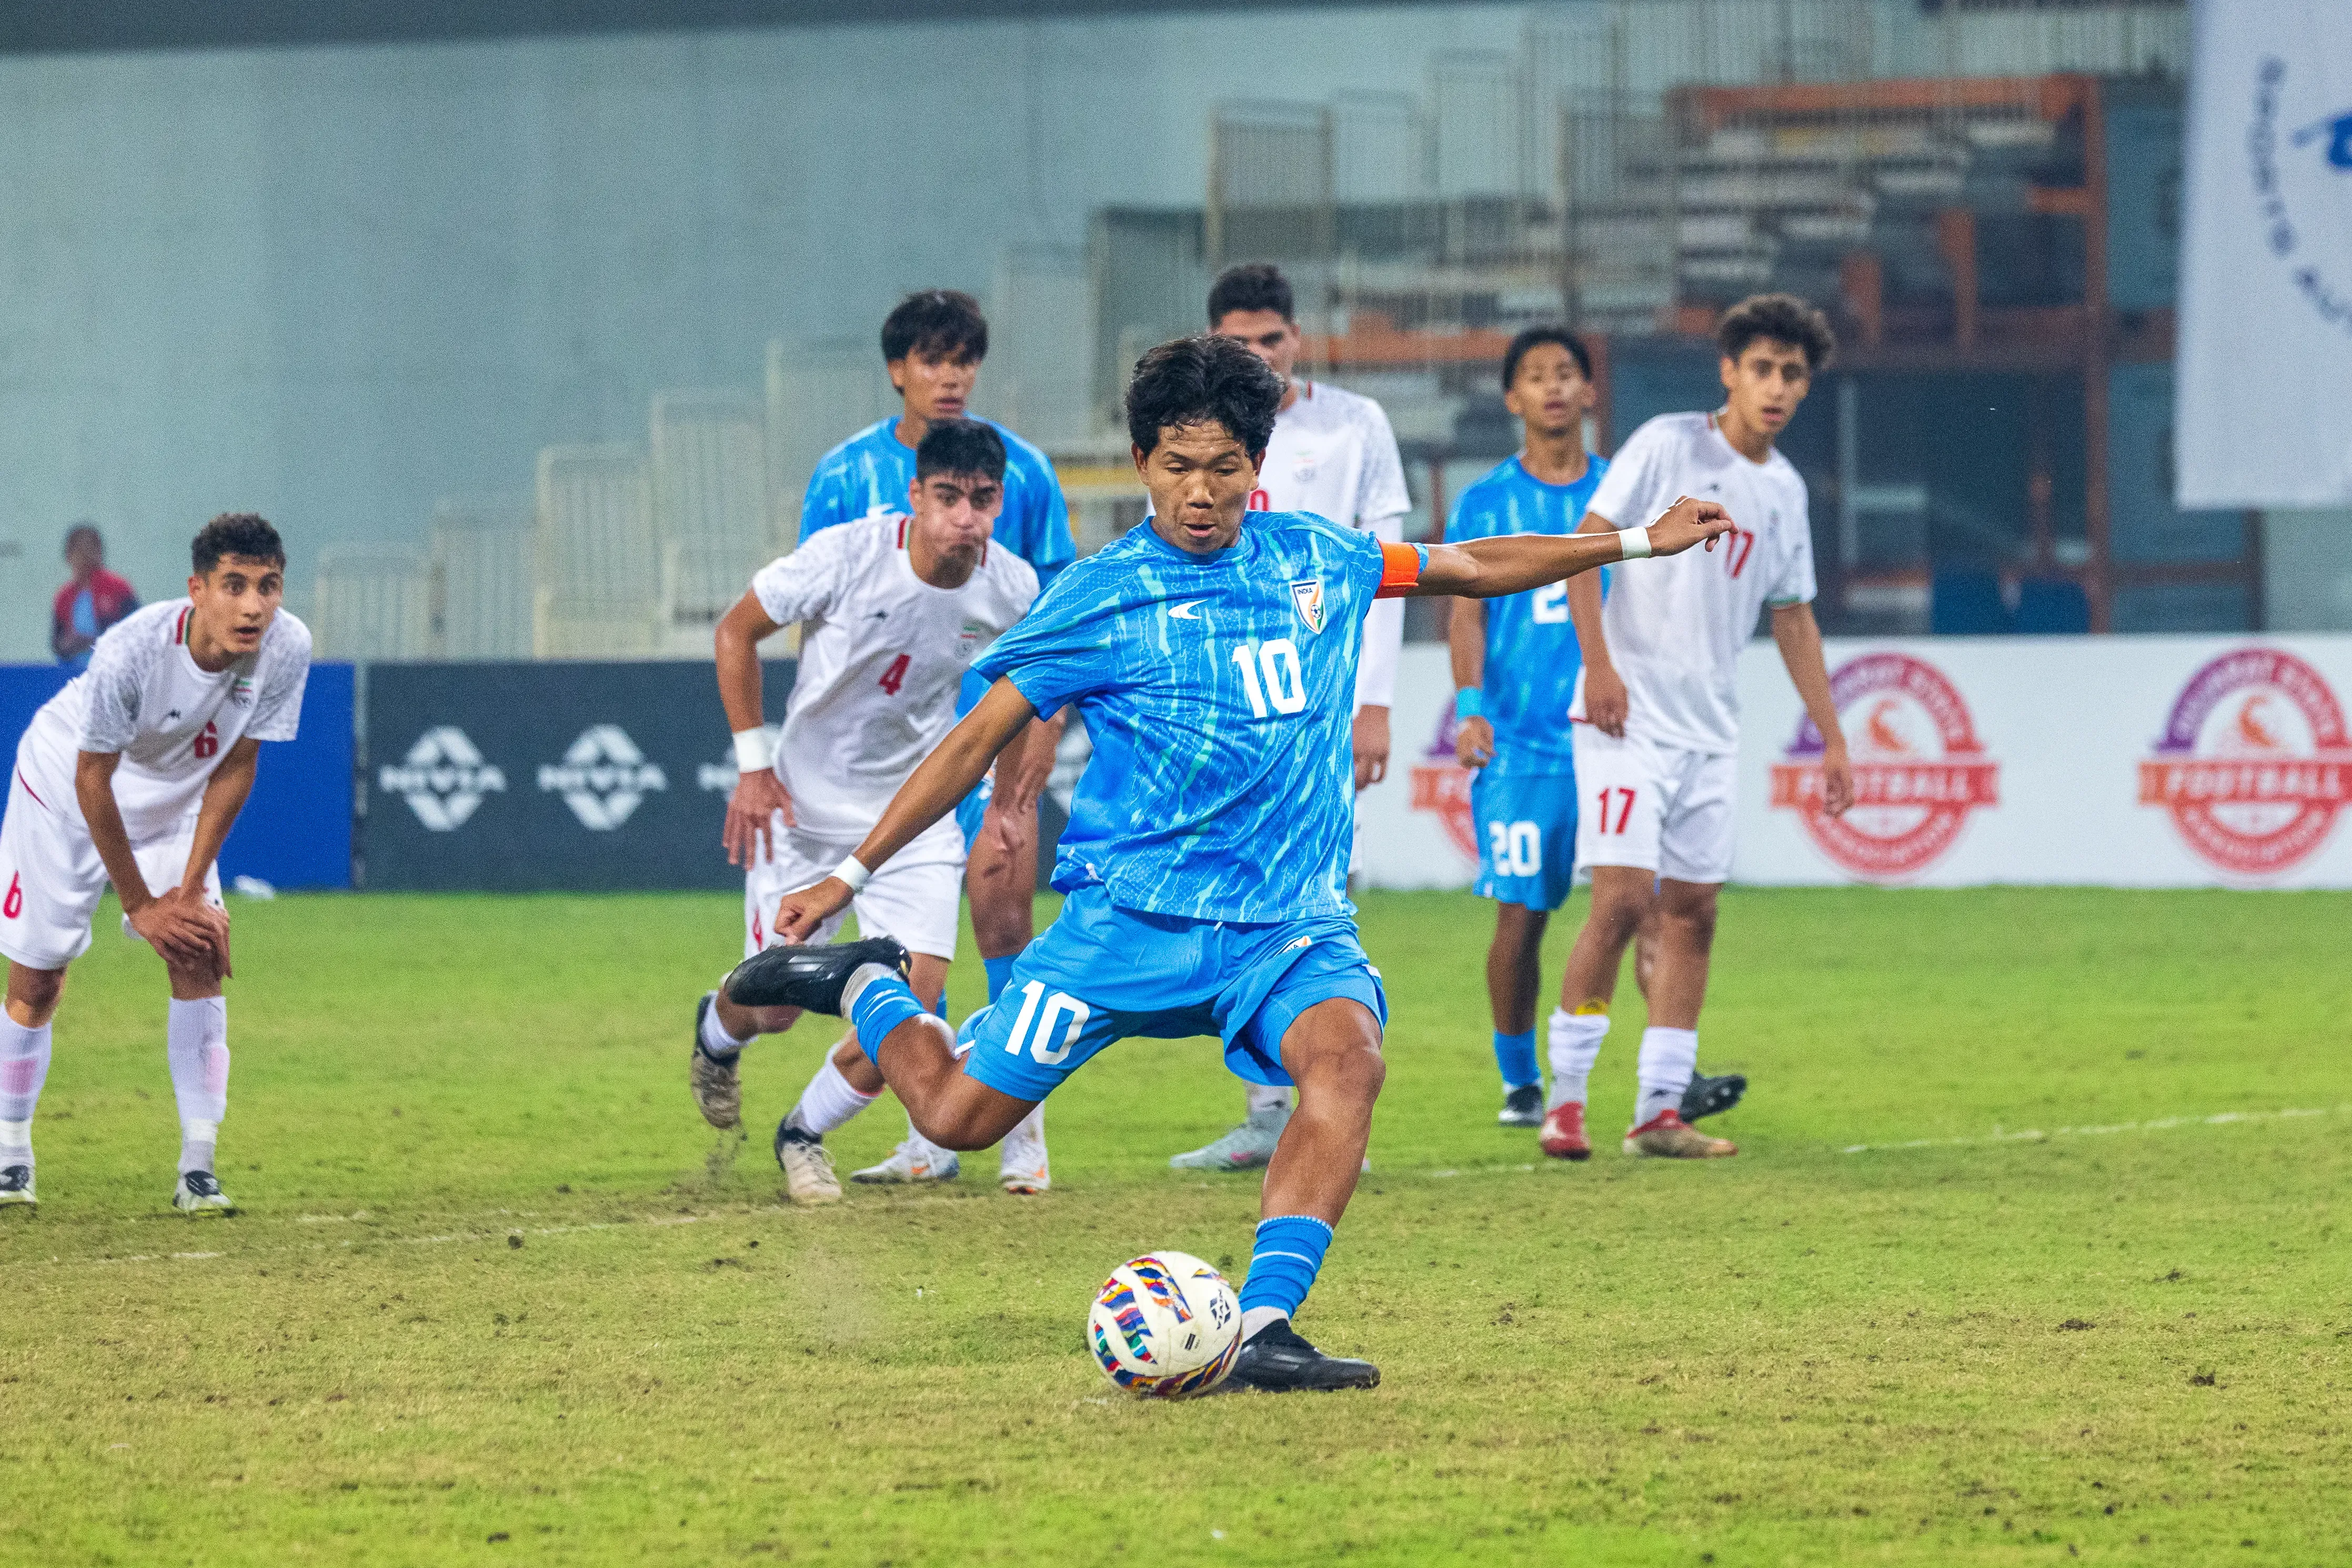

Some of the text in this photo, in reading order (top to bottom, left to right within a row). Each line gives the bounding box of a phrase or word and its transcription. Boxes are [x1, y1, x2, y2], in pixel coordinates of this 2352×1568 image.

[1725, 530, 1754, 579] 17
[1296, 587, 1313, 595] INDIA
[1532, 578, 1569, 624] 2
[878, 654, 912, 696] 4
[1231, 638, 1307, 719] 10
[194, 719, 218, 758] 6
[2166, 767, 2342, 798] FOOTBALL
[1599, 787, 1636, 835] 17
[1489, 820, 1542, 878] 20
[3, 870, 22, 919] 6
[1004, 980, 1090, 1066] 10
